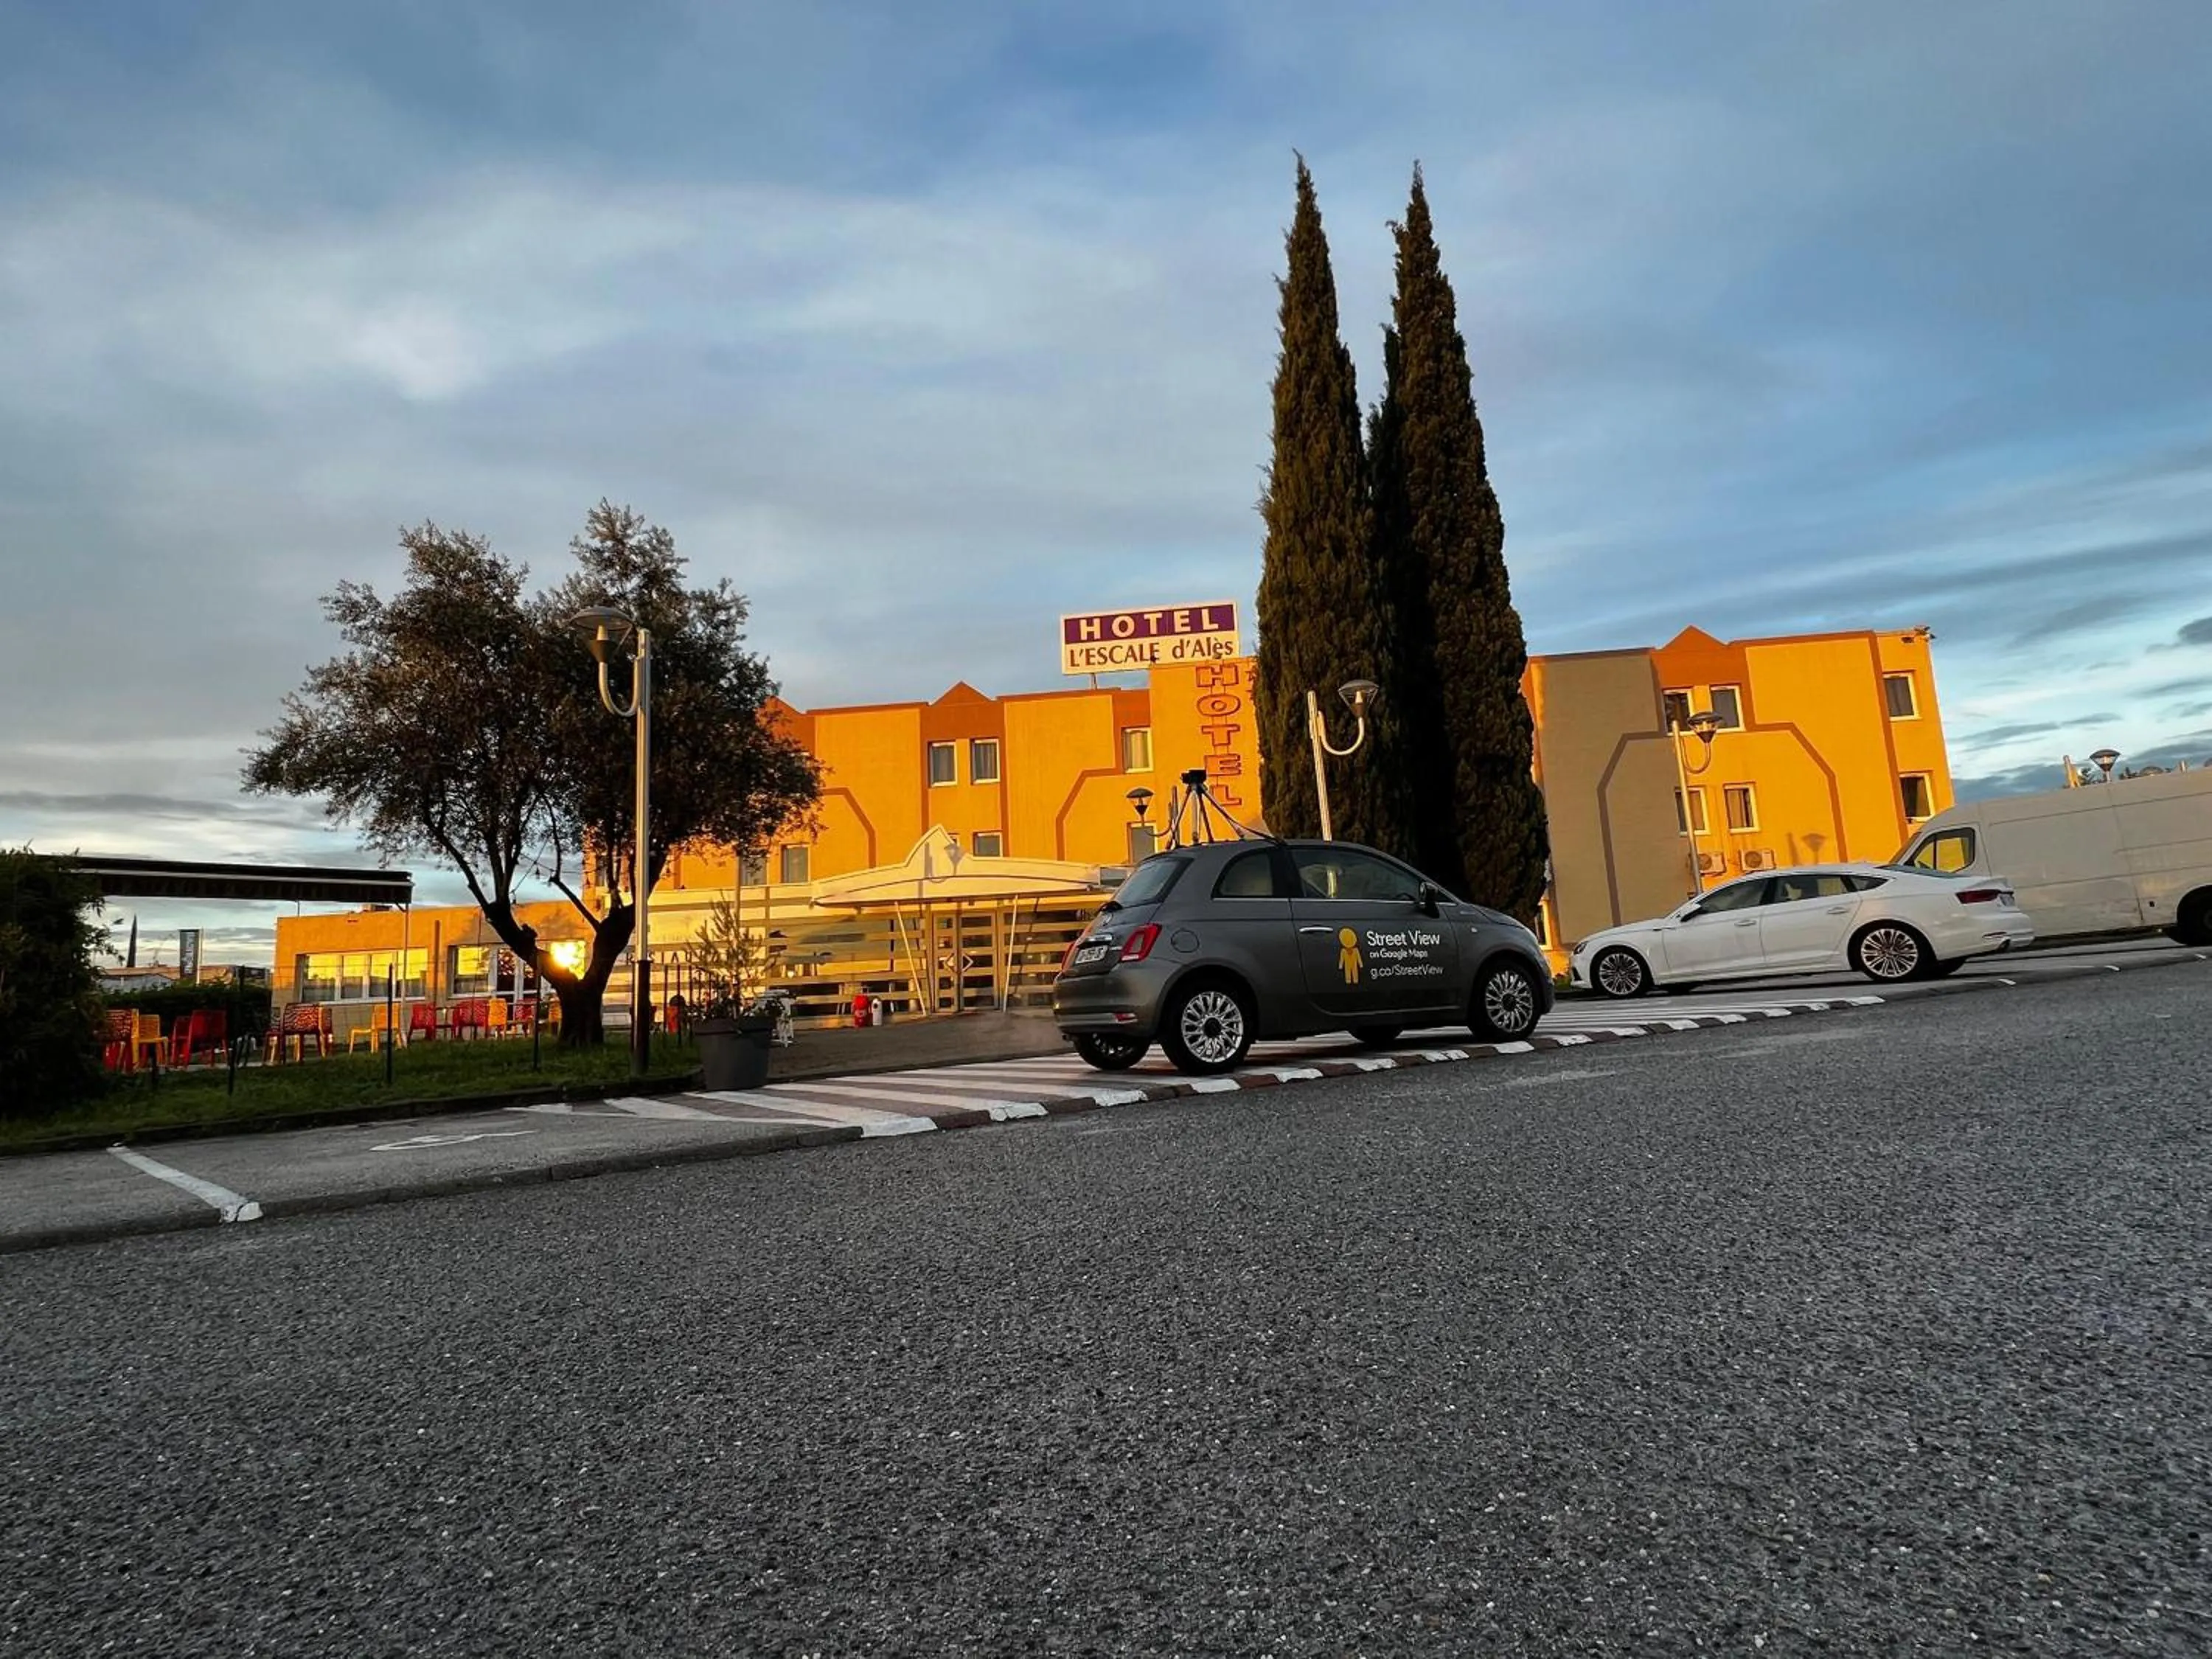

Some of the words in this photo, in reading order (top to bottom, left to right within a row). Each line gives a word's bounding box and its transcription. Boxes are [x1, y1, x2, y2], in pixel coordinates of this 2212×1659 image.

[1079, 608, 1219, 641] HOTEL
[1172, 637, 1234, 658] d'Alès
[1195, 663, 1242, 806] HOTEL
[1366, 930, 1407, 946] Street
[1408, 930, 1441, 945] View
[1380, 947, 1408, 960] Google
[1408, 948, 1428, 959] Maps
